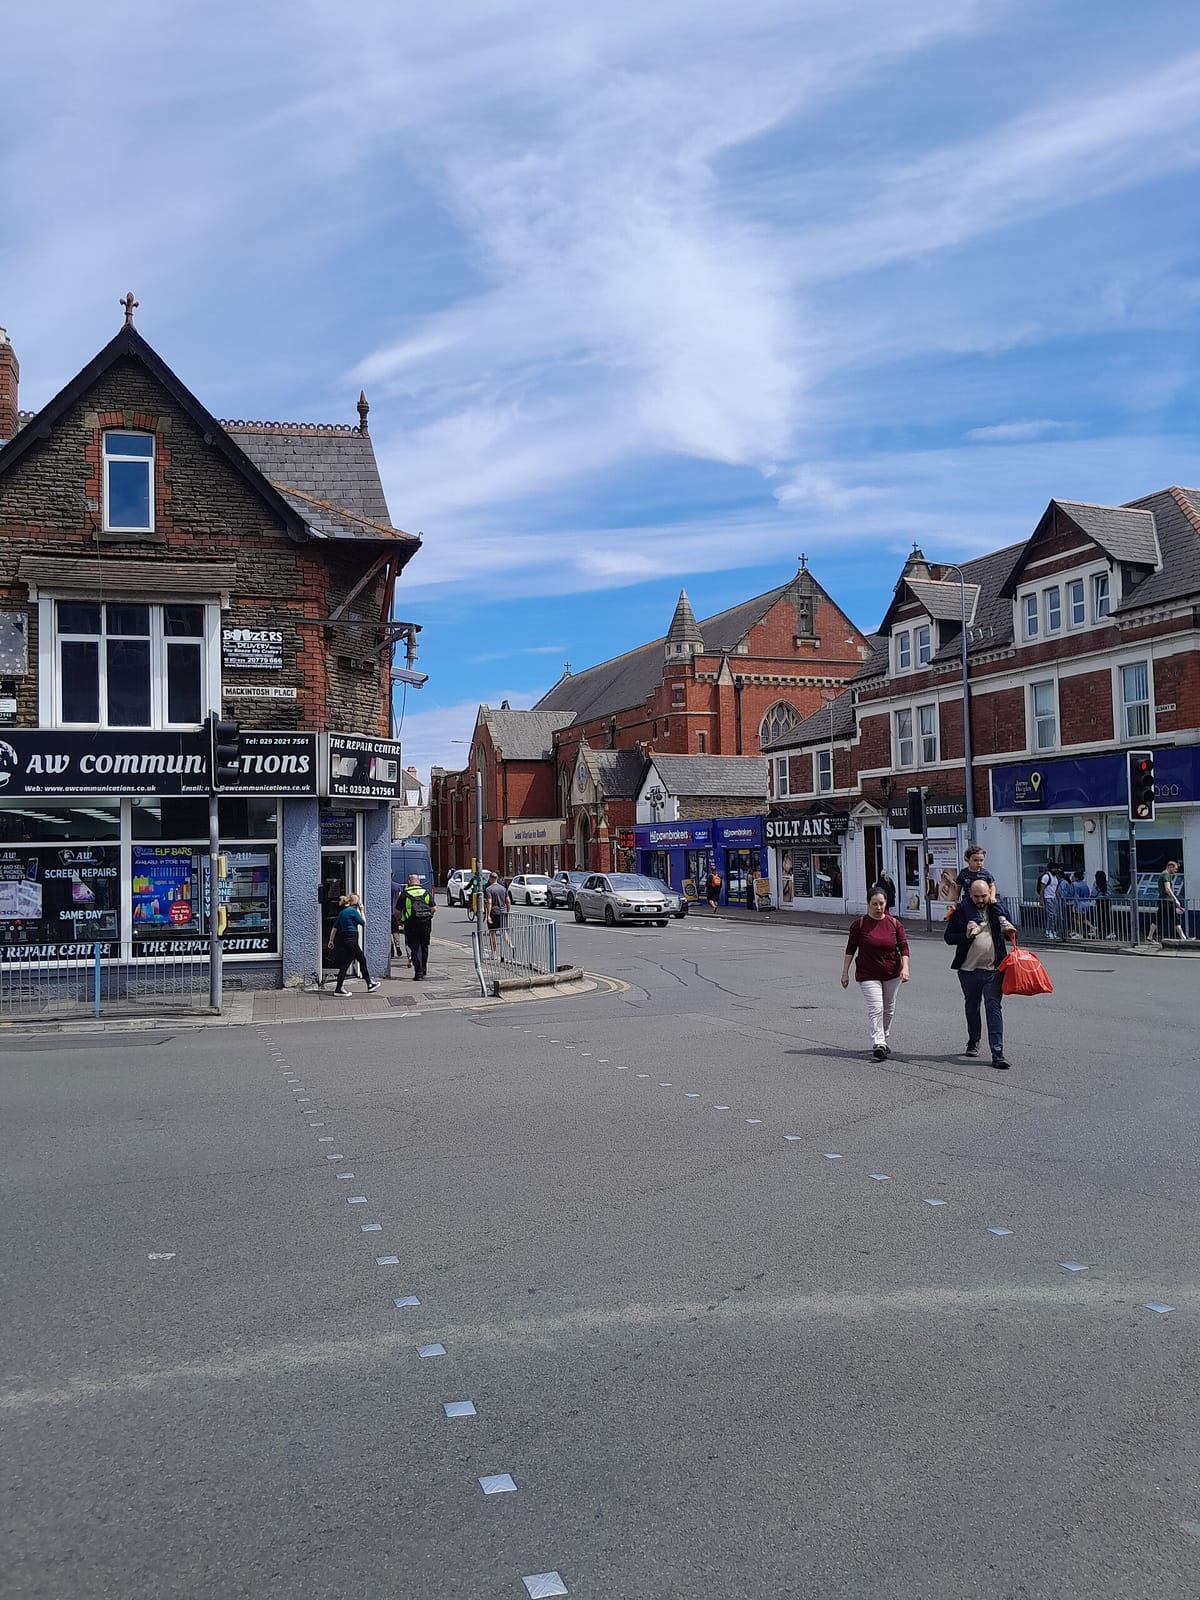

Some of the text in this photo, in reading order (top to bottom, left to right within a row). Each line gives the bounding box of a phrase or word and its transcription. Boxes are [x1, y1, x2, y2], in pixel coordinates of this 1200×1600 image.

[225, 688, 294, 697] MACKINTOSH PLACE
[330, 737, 400, 755] THE REPAIR CENTRE
[26, 754, 70, 774] AW
[334, 783, 395, 796] Tel: 02920 217561
[891, 807, 909, 816] SULT
[766, 818, 832, 837] SULTANS
[77, 852, 93, 860] AW
[155, 848, 170, 856] ELF
[171, 847, 193, 856] BARS
[45, 868, 117, 879] SCREEN REPAIRS
[60, 910, 102, 920] SAME DAY
[7, 945, 57, 957] REPAIR
[142, 938, 269, 953] THE REPAI CENTRE
